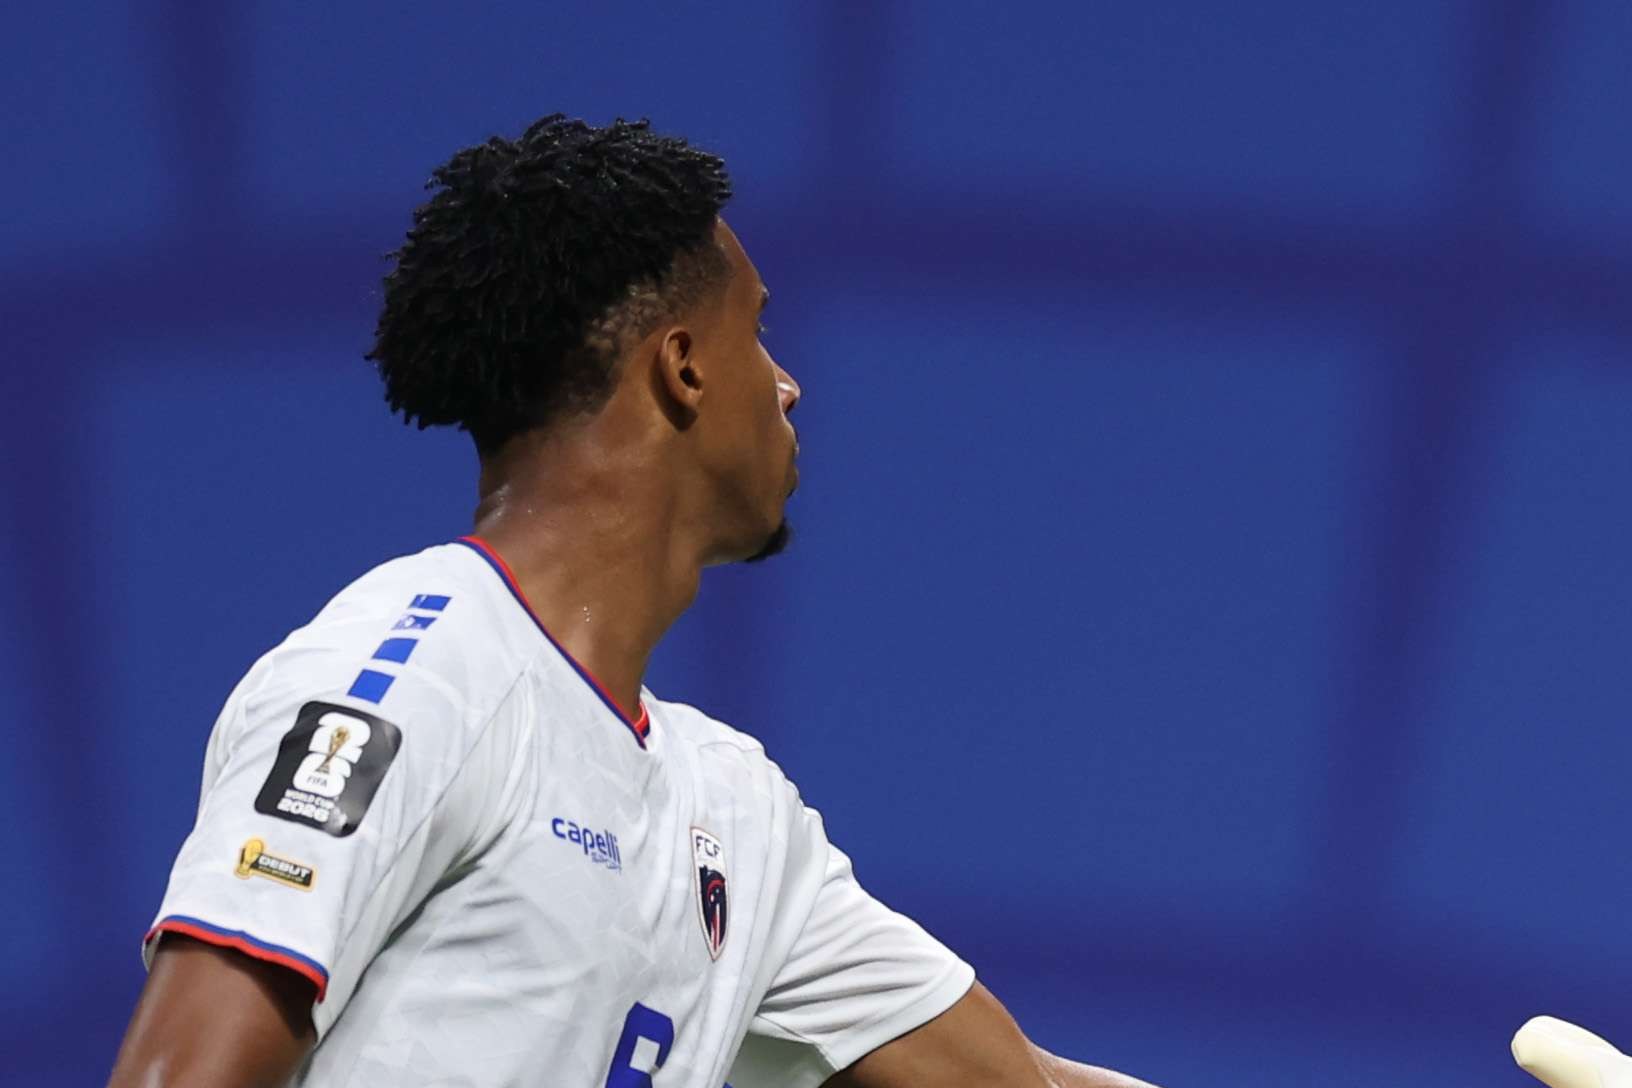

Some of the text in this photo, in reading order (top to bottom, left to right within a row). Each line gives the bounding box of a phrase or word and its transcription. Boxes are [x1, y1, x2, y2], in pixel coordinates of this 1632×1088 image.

[277, 798, 330, 822] 2026
[552, 817, 621, 865] capelli
[695, 835, 721, 858] FCF
[258, 854, 311, 878] DEBUT
